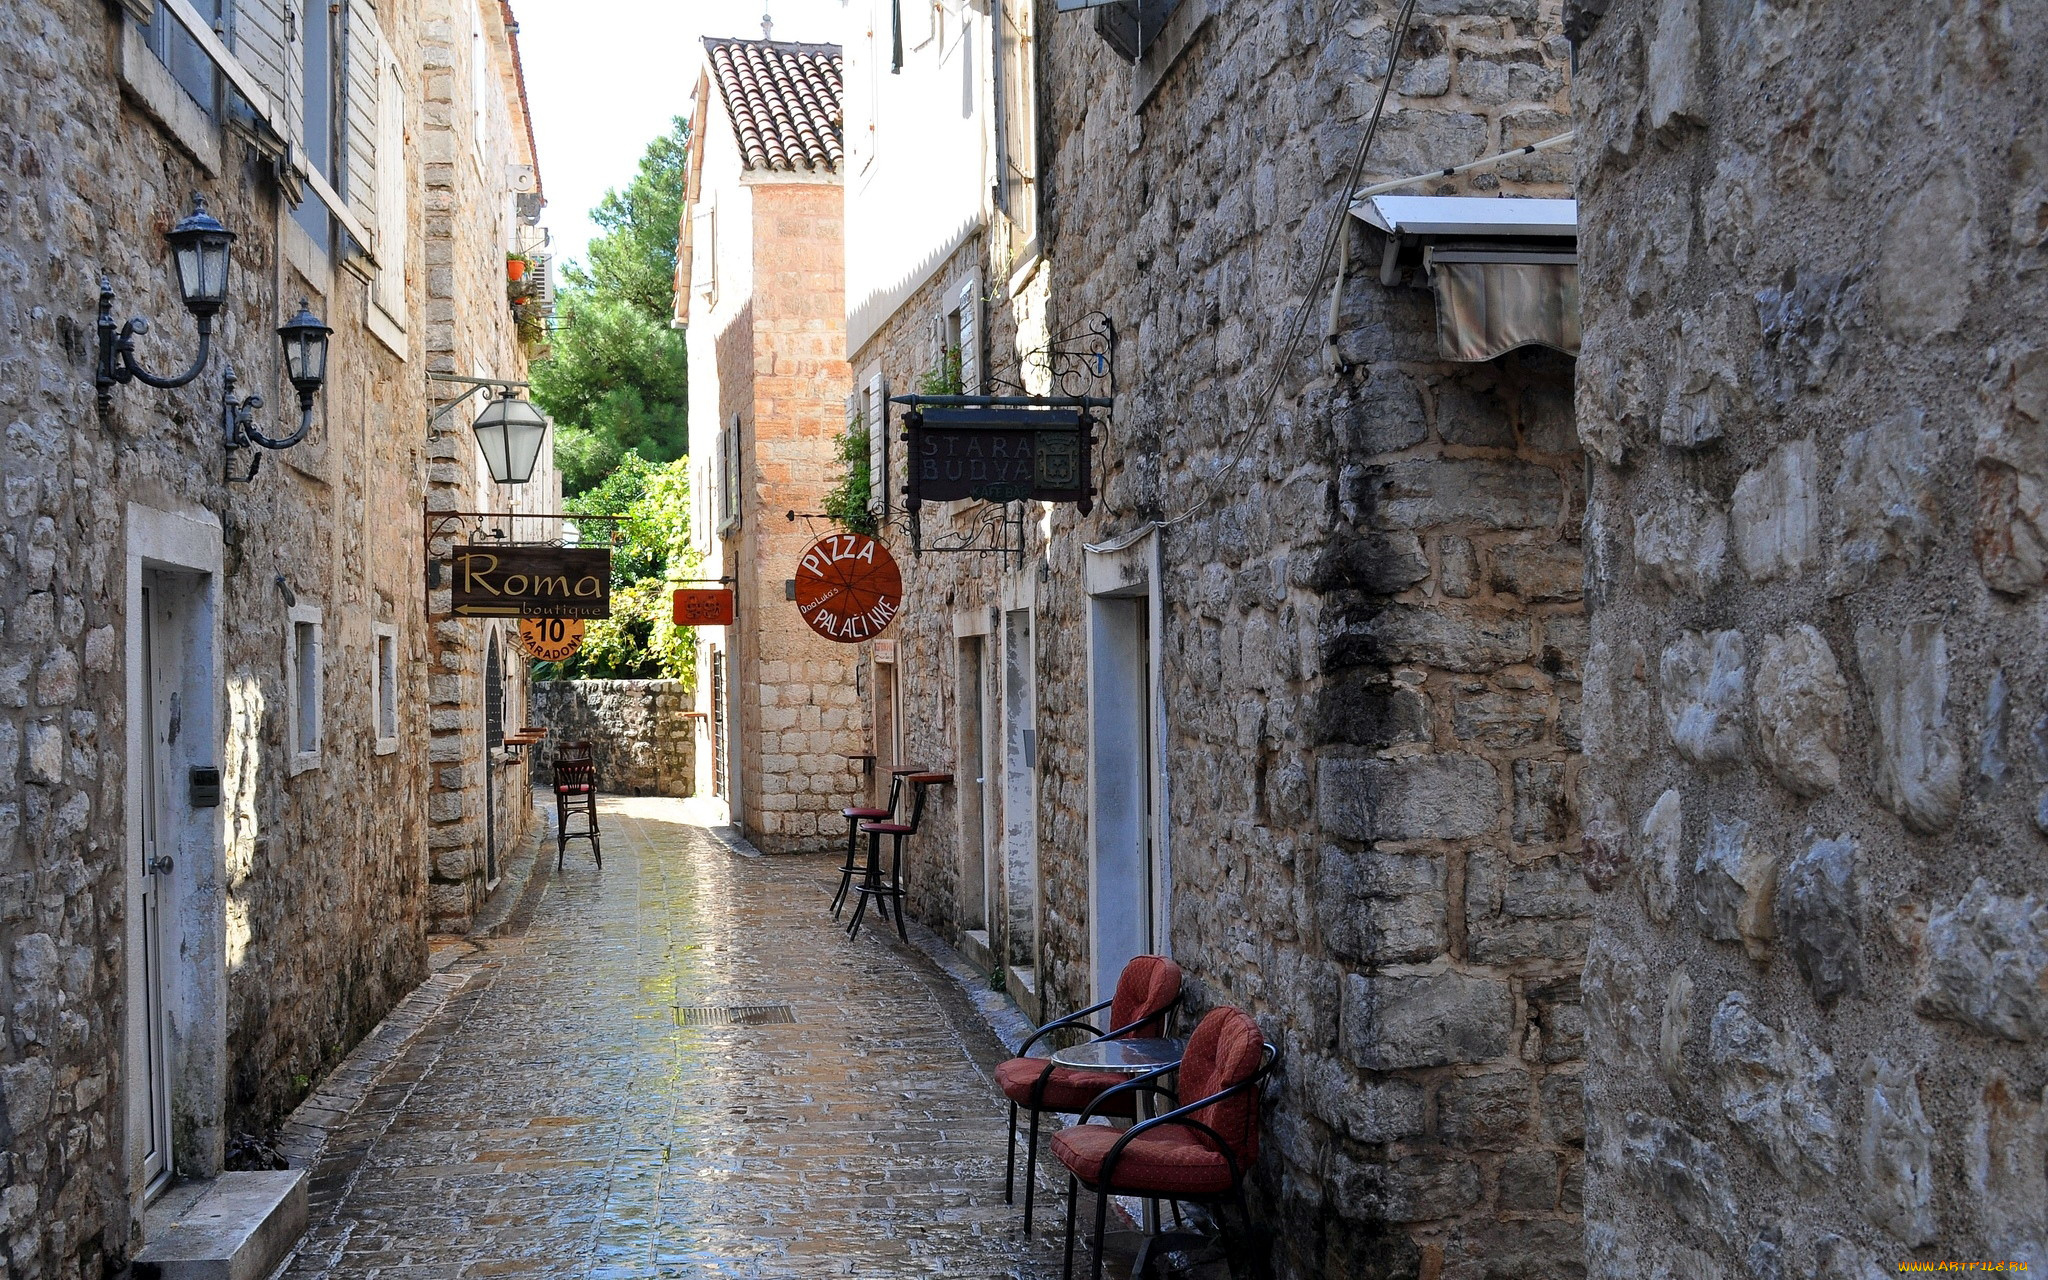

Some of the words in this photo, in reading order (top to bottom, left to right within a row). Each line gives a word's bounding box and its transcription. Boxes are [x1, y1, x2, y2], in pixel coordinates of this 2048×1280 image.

[921, 435, 1033, 458] STARA
[921, 458, 1031, 481] BUDVA
[801, 535, 875, 577] PIZZA
[457, 552, 602, 599] Roma
[522, 601, 601, 618] boutique
[535, 618, 565, 642] 10
[522, 631, 583, 659] MARADONA
